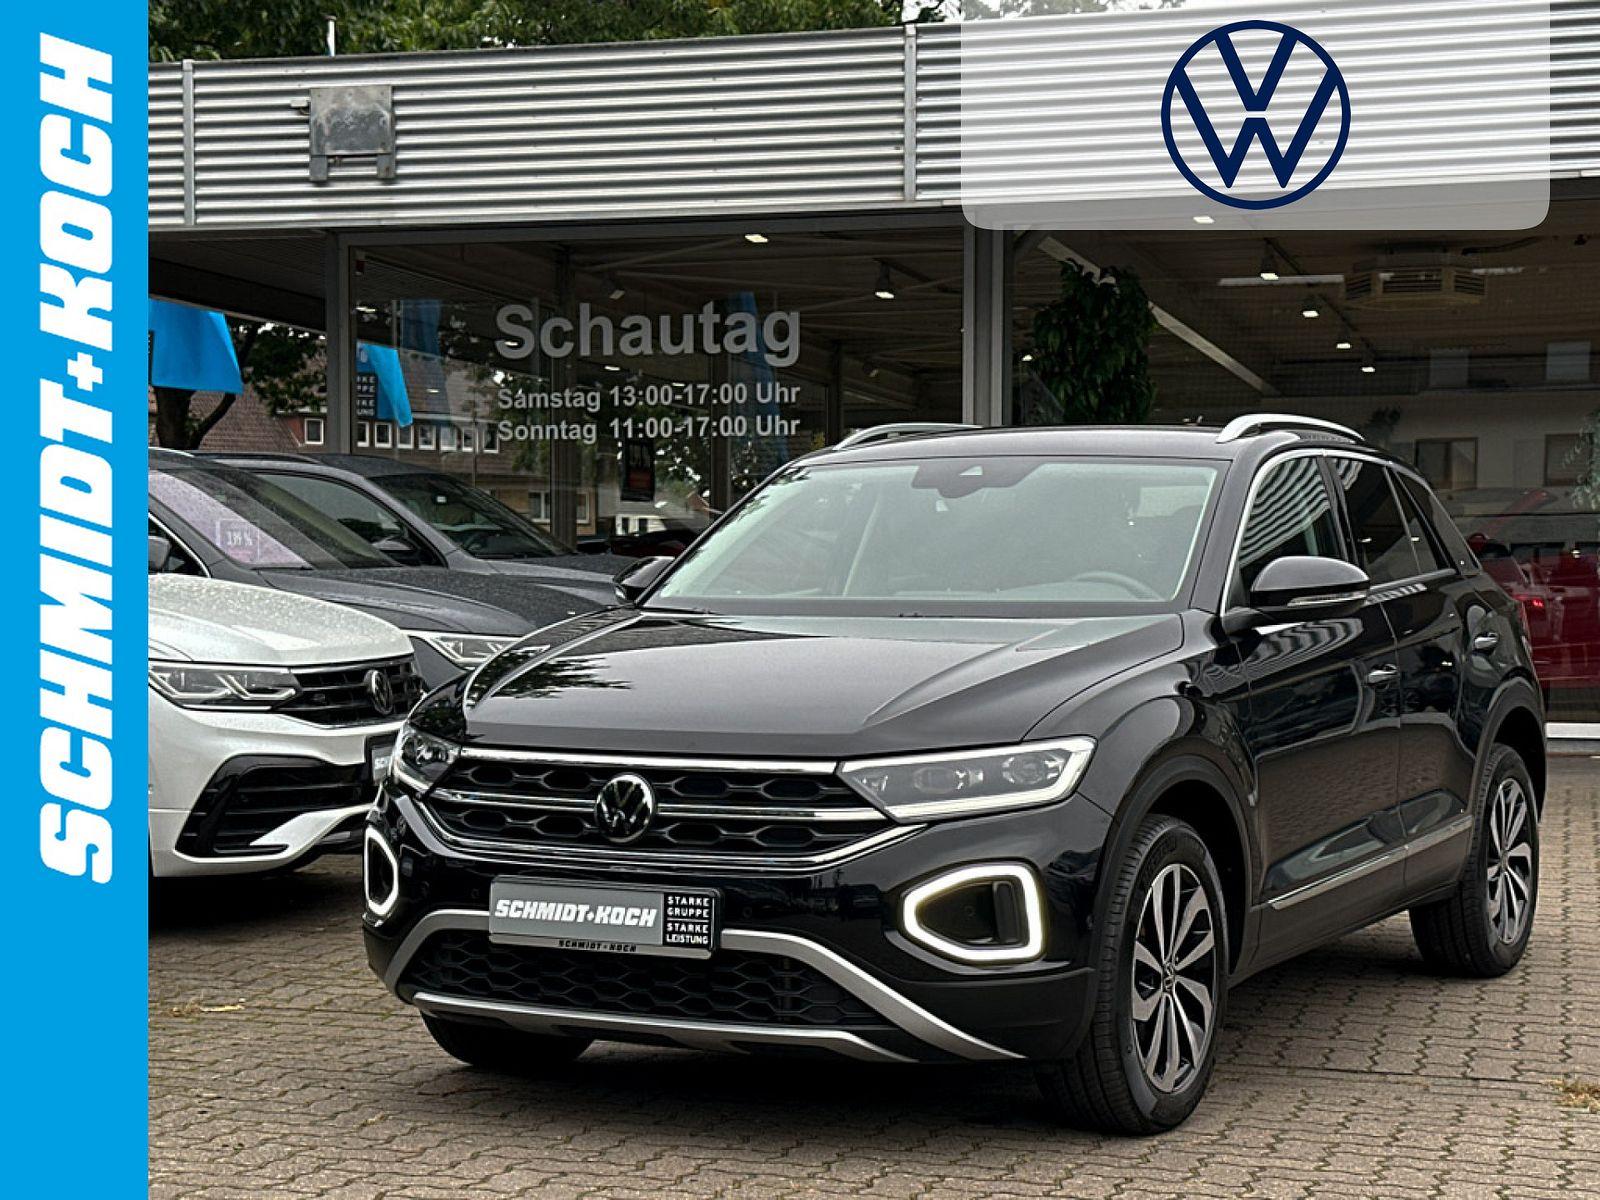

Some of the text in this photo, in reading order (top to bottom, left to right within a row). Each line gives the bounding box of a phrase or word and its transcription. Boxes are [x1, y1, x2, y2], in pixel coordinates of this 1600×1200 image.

[495, 301, 799, 367] Schautag
[499, 382, 801, 412] Samstag 13:00-17:00 Uhr
[499, 415, 801, 445] Sonntag 11:00-17:00 Uhr
[667, 896, 710, 907] STARKE
[495, 899, 657, 927] SCHMIDT+KOCH
[667, 906, 709, 918] GRUPPE
[666, 922, 709, 934] STARKE
[665, 933, 709, 945] LEISTUNG
